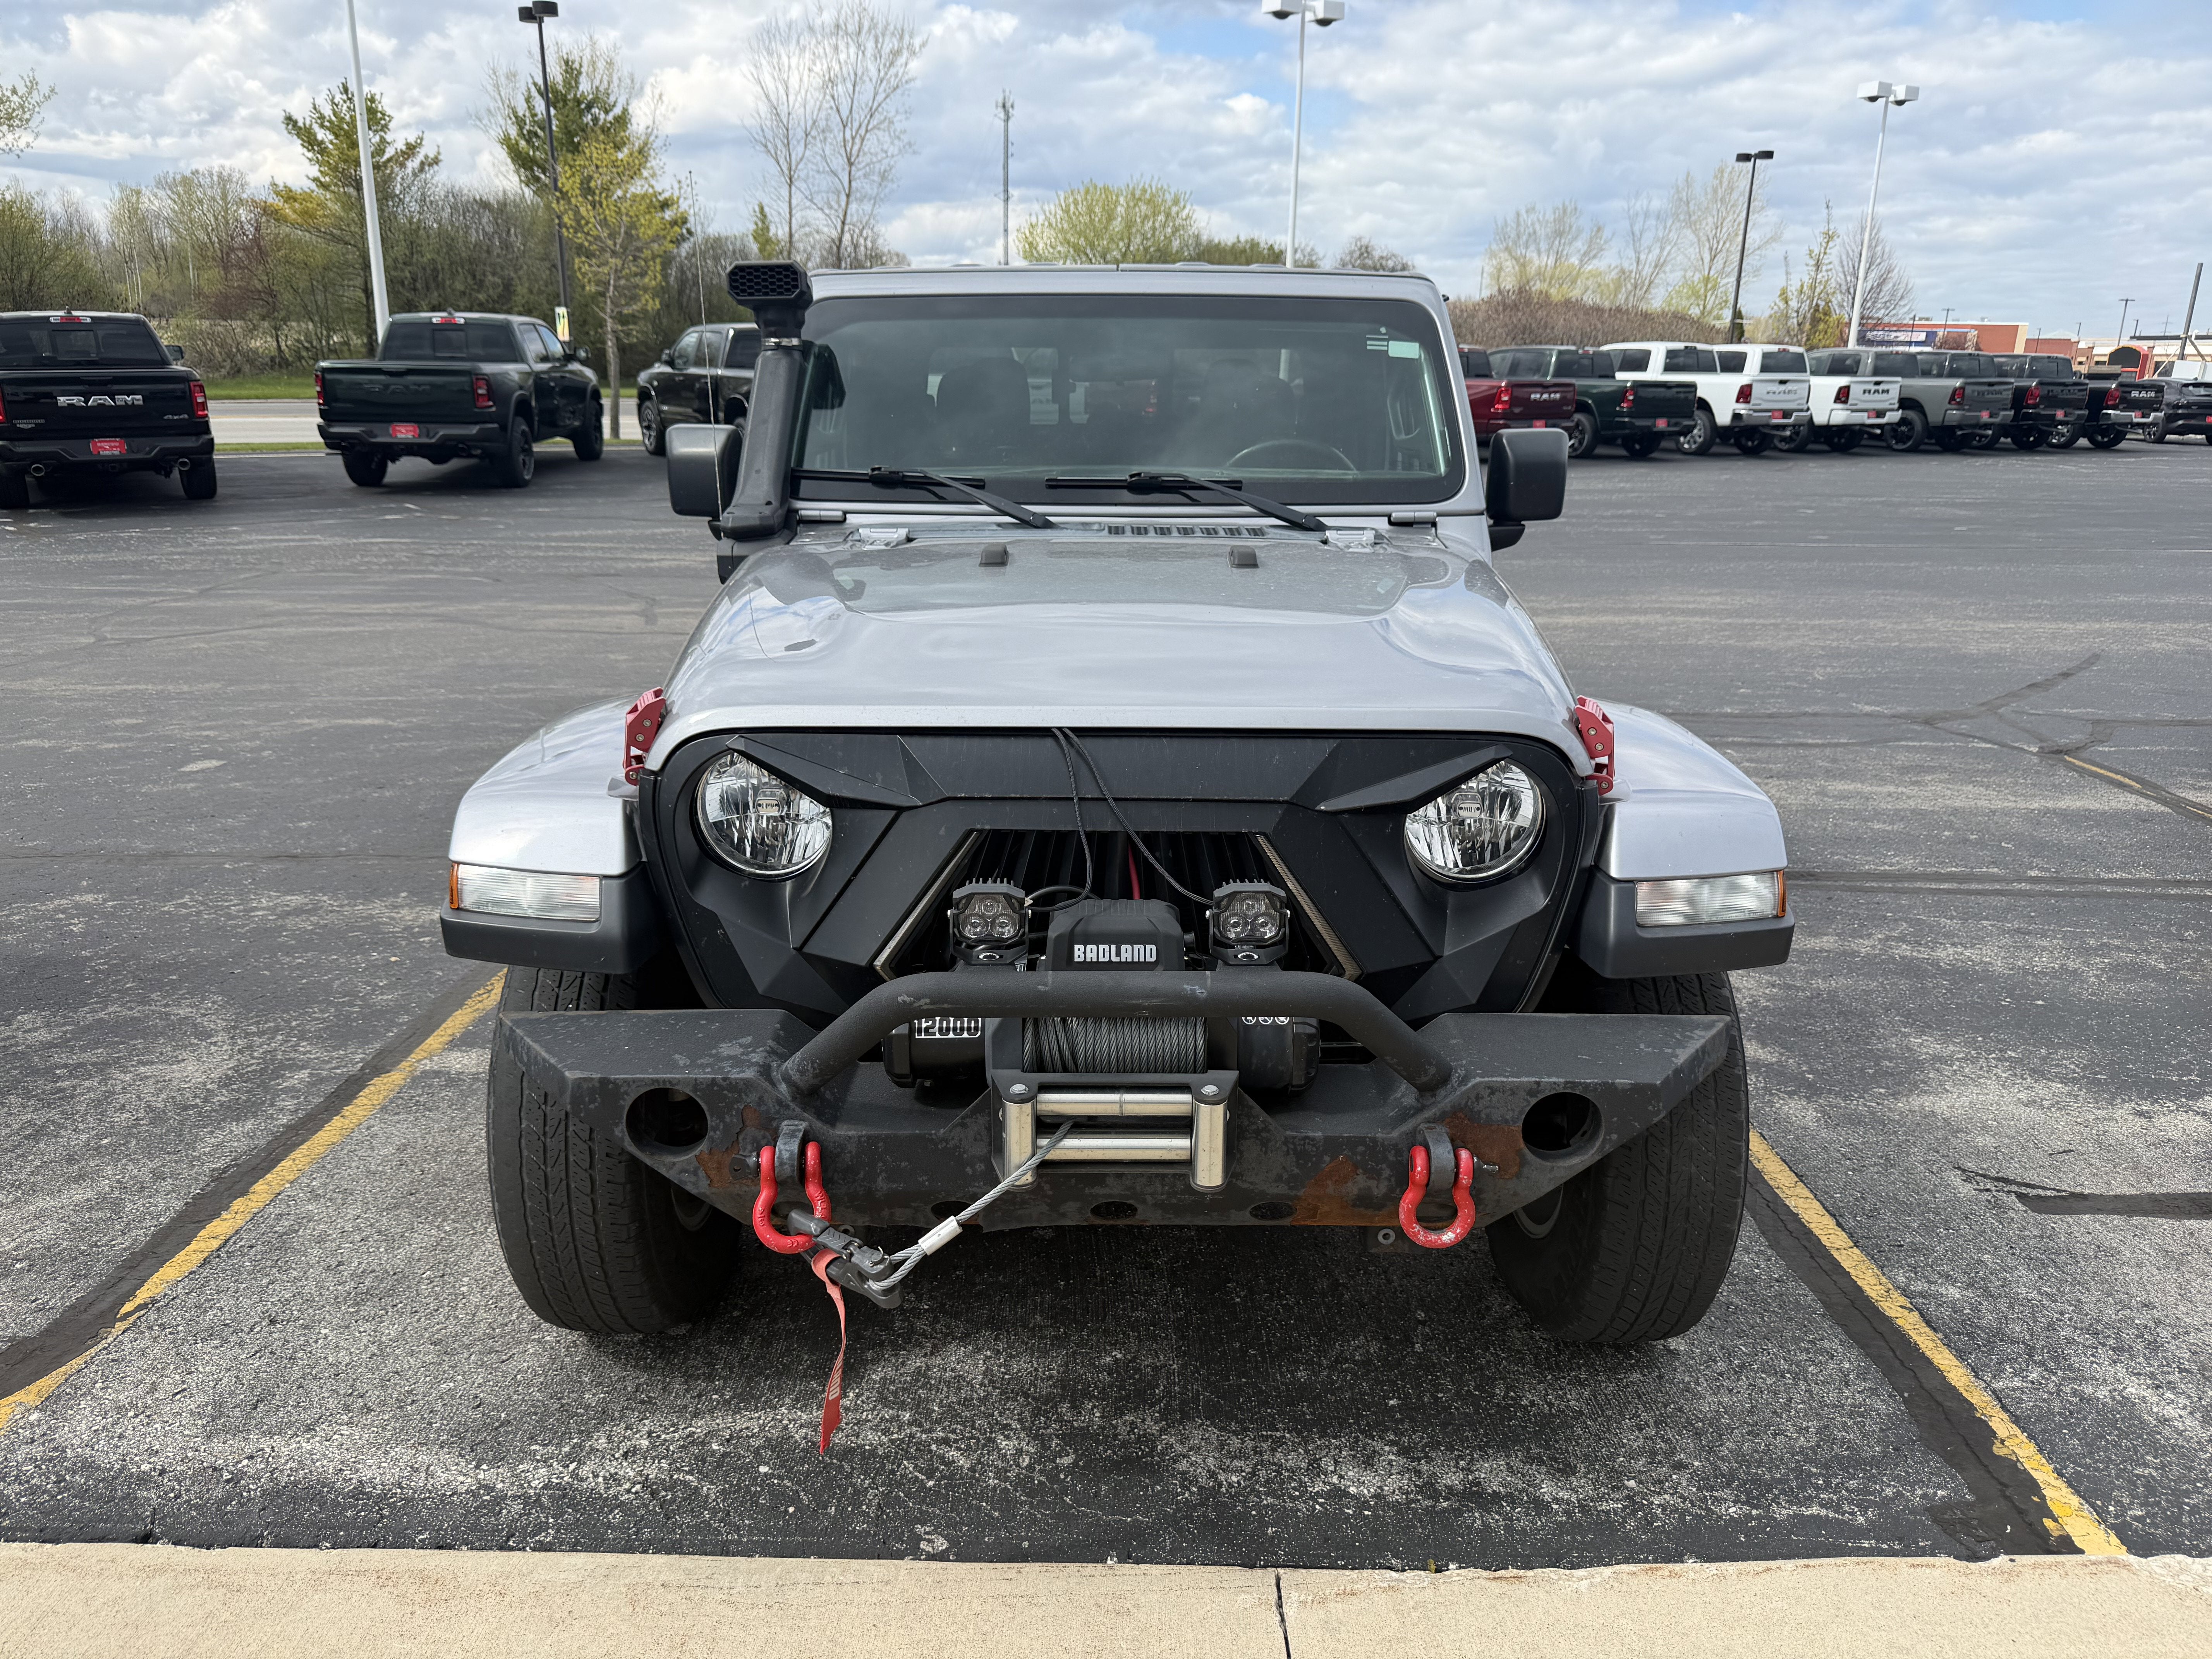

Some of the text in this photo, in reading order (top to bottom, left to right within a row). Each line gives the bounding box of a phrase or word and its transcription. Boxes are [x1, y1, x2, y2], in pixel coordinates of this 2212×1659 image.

[57, 395, 143, 407] RAM
[1530, 393, 1561, 401] RAM
[1074, 944, 1156, 962] BADLAND
[914, 1017, 981, 1038] 12000
